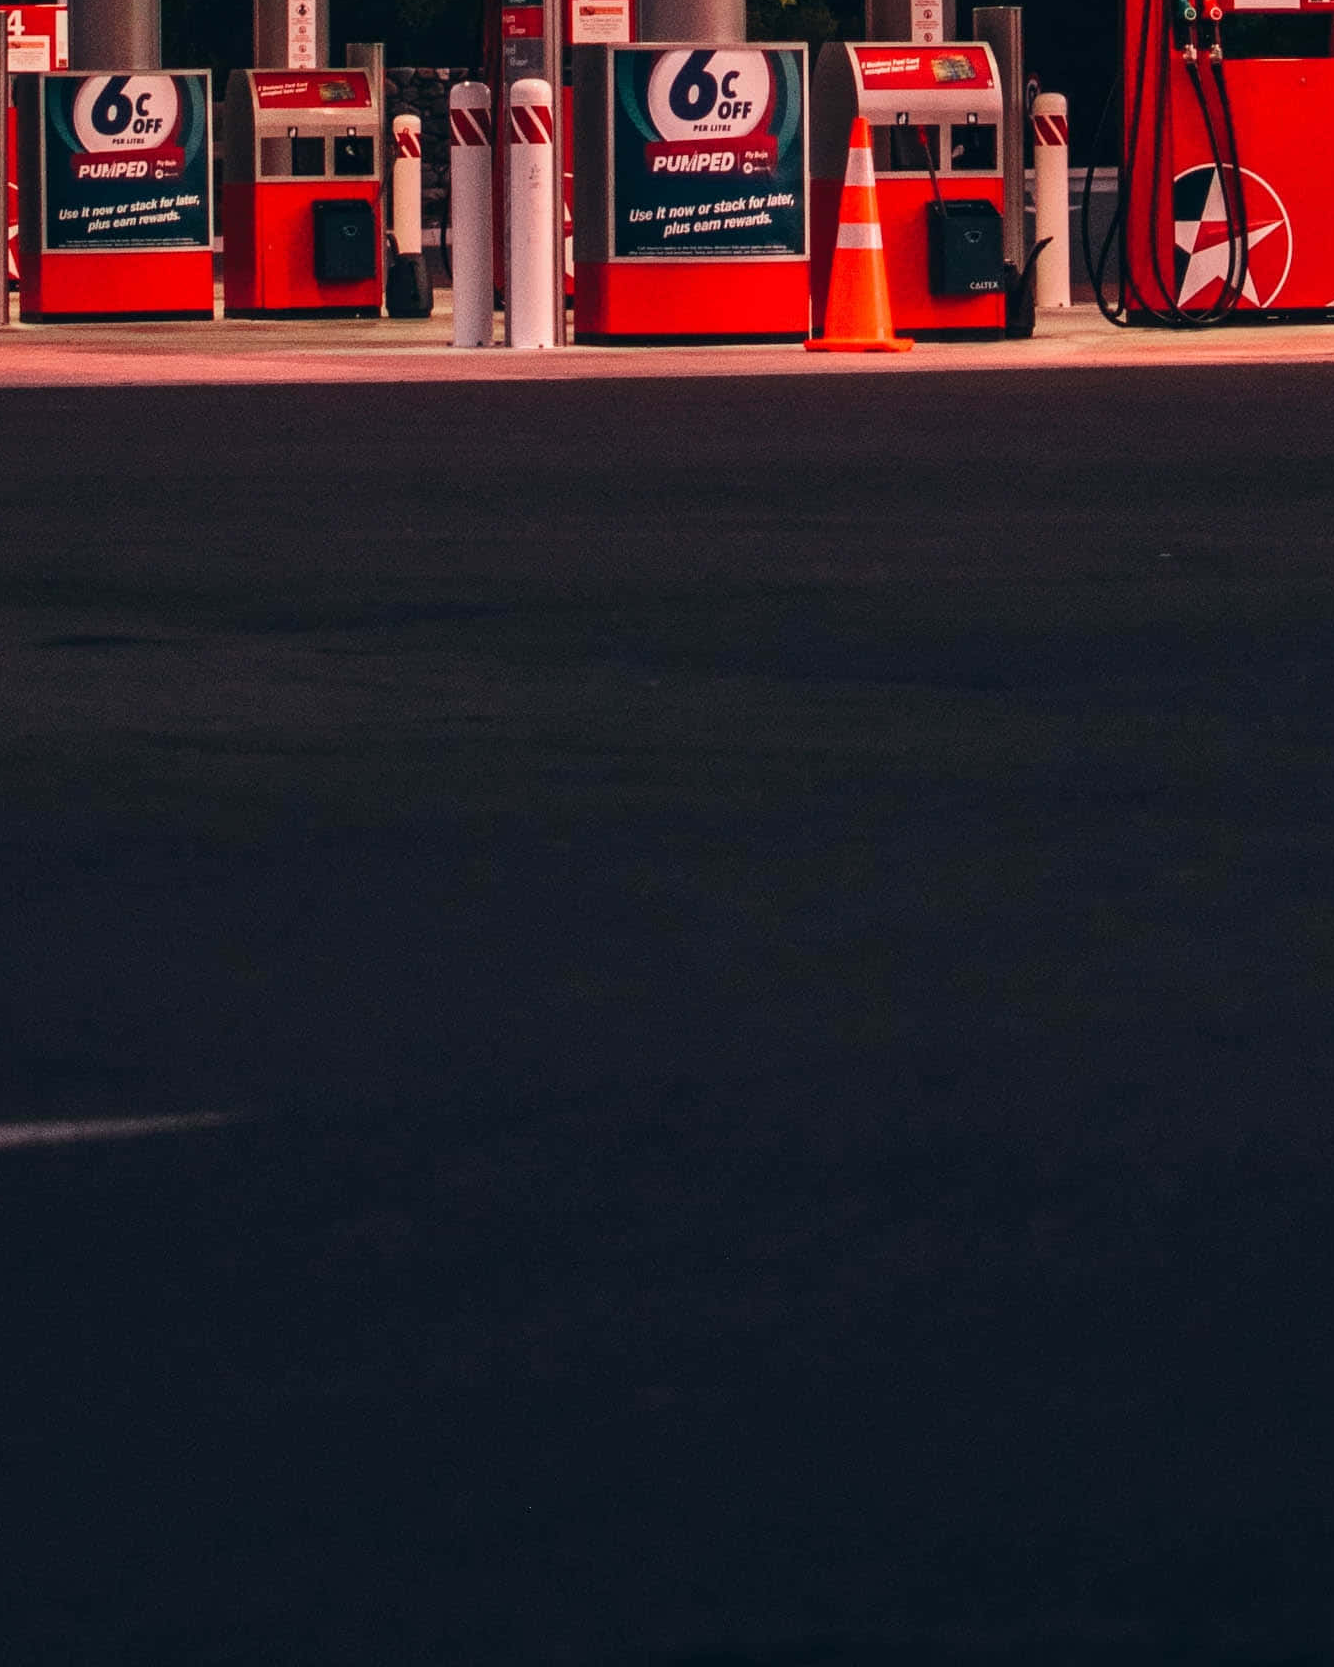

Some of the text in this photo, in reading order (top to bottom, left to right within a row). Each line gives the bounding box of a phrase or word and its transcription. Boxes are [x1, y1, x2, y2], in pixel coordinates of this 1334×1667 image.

[7, 10, 26, 36] 4
[718, 101, 752, 119] OFF
[132, 119, 163, 134] OFF
[78, 161, 148, 179] PUMPED
[652, 150, 735, 173] PUMPED
[629, 193, 795, 223] Use it now or stack for later,
[663, 212, 772, 240] plus earn rewards.
[969, 281, 999, 290] CALTEX
